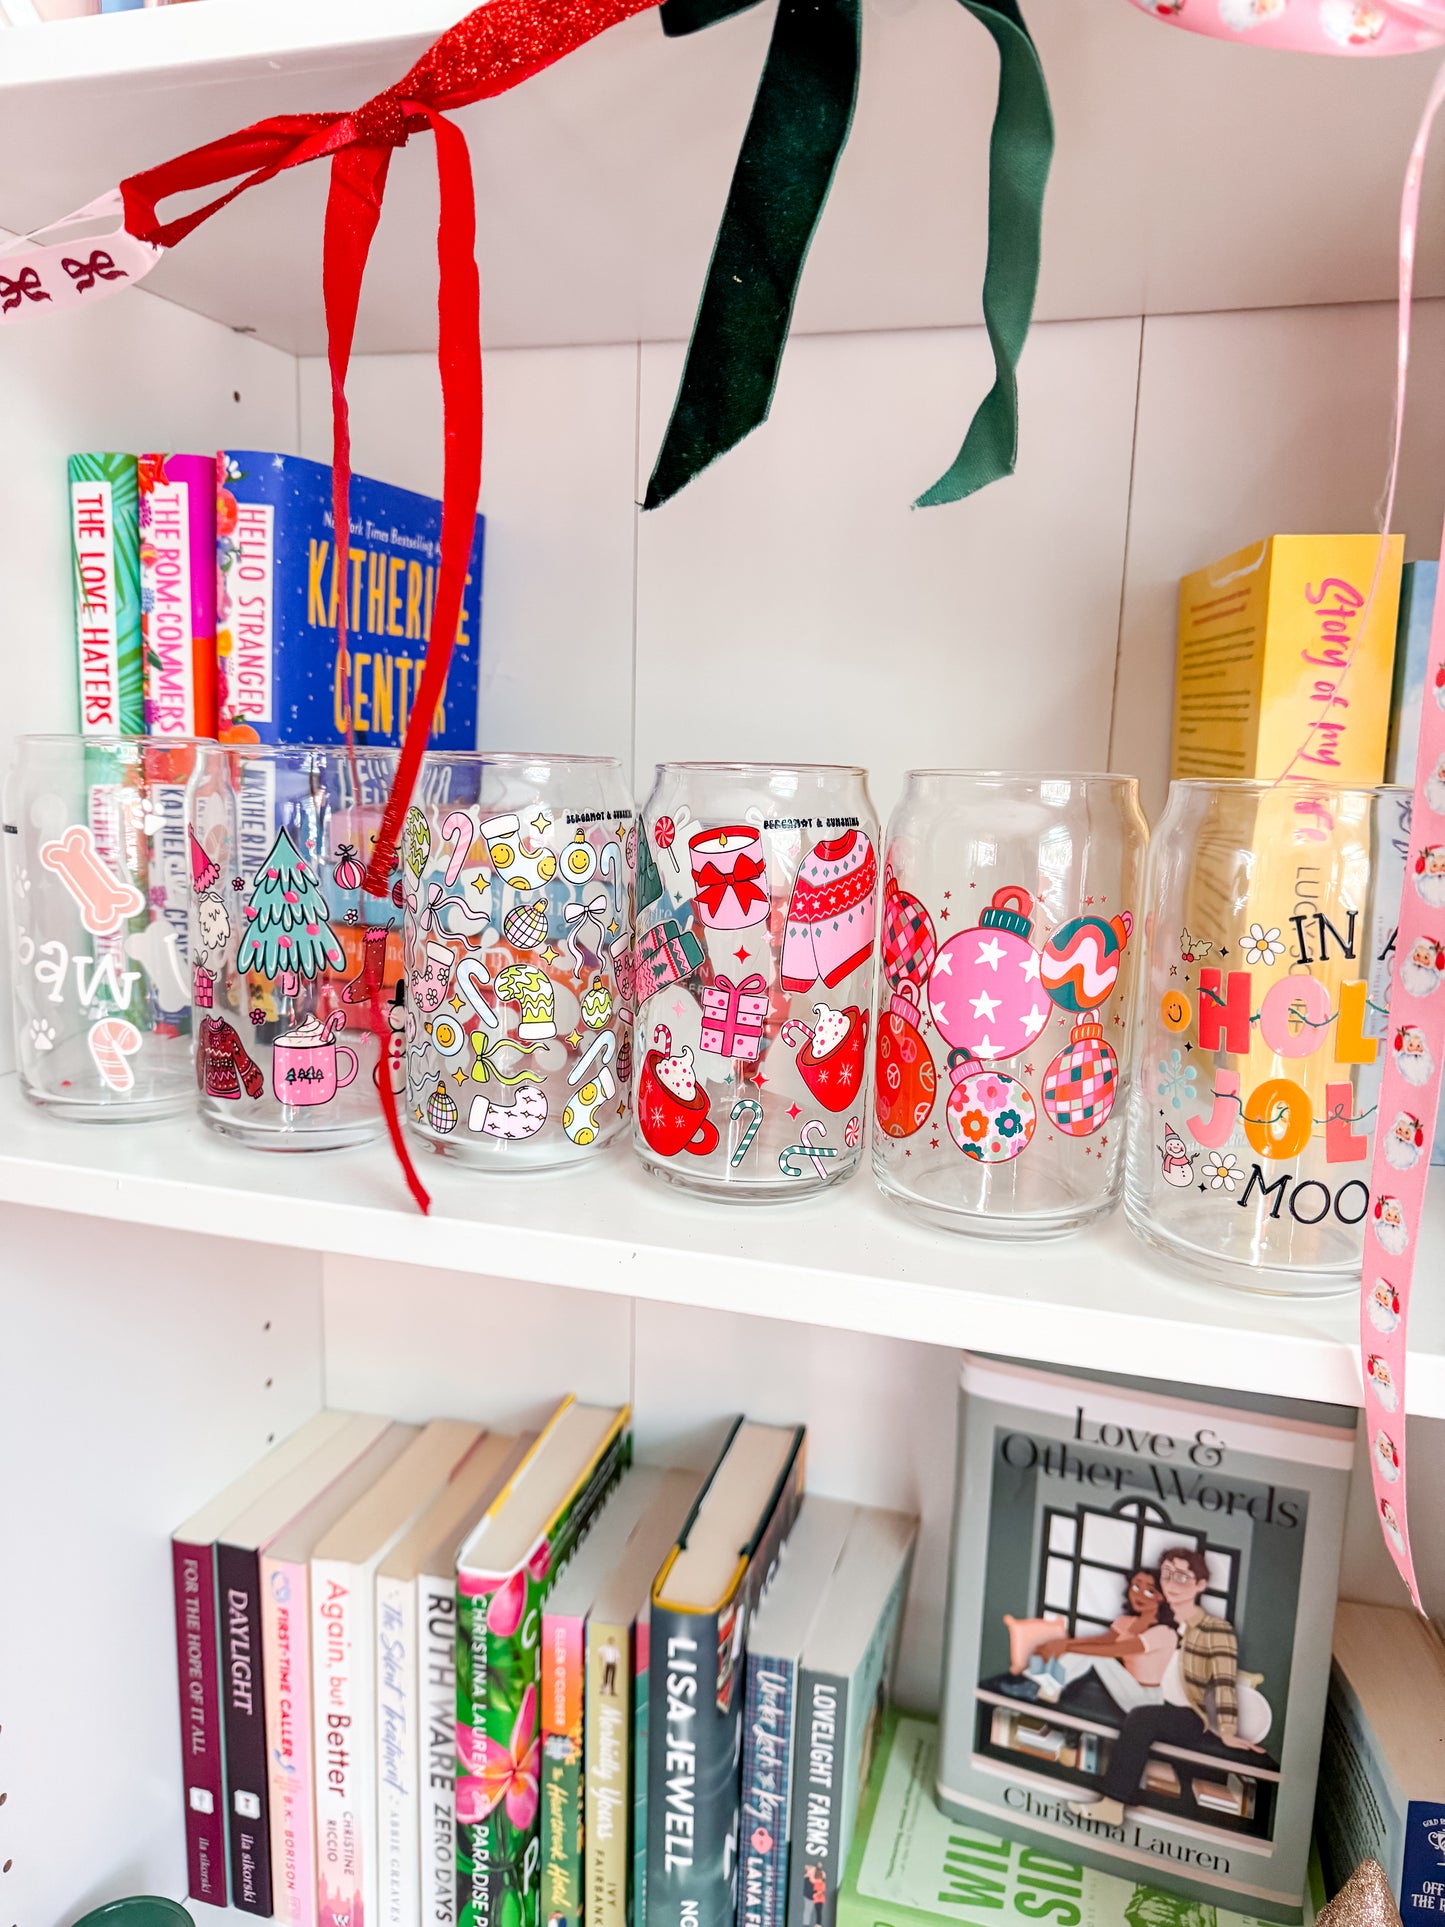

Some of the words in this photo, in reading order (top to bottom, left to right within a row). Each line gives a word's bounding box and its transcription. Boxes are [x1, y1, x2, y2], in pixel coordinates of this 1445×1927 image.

[77, 493, 105, 540] THE
[153, 494, 180, 540] THE
[237, 507, 267, 583] HELLO
[366, 520, 389, 543] Times
[390, 527, 433, 559] Bestselling
[79, 550, 108, 617] LOVE
[155, 548, 187, 734] ROM-COMMERS
[1301, 577, 1364, 668] Story
[82, 624, 113, 726] HATERS
[238, 596, 269, 719] STRANGER
[1310, 681, 1349, 709] of
[1300, 722, 1346, 767] my
[816, 818, 823, 828] &
[1289, 909, 1359, 965] IN
[1197, 967, 1379, 1065] HOL
[1186, 1068, 1369, 1164] JOL
[1237, 1163, 1370, 1225] MOO
[1074, 1406, 1176, 1459] Love
[1188, 1428, 1227, 1467] &
[1001, 1431, 1134, 1493] Other
[1148, 1462, 1300, 1530] Words
[183, 1558, 201, 1594] FOR
[185, 1595, 200, 1633] THE
[318, 1580, 353, 1669] Again,
[380, 1602, 405, 1632] The
[428, 1593, 455, 1688] RUTH
[187, 1634, 202, 1680] HOPE
[228, 1588, 254, 1715] DAYLIGHT
[276, 1607, 292, 1692] FIRST-TIME
[380, 1633, 407, 1697] Silent
[471, 1594, 488, 1697] CHRISTINA
[188, 1681, 204, 1704] OF
[329, 1676, 346, 1707] but
[665, 1637, 699, 1722] LISA
[755, 1669, 788, 1727] Under
[190, 1704, 205, 1725] IT
[191, 1725, 206, 1756] ALL
[280, 1698, 294, 1758] CALLER
[430, 1698, 455, 1792] WARE
[471, 1702, 489, 1777] LAUREN
[592, 1704, 624, 1780] Morbidly
[808, 1683, 838, 1789] LOVELIGHT
[327, 1713, 352, 1798] Better
[546, 1783, 569, 1861] Heartbreak
[590, 1786, 624, 1840] Yours
[664, 1732, 697, 1874] JEWELL
[744, 1788, 786, 1823] Key
[804, 1791, 832, 1858] FARMS
[1002, 1785, 1126, 1845] Christina
[1132, 1826, 1232, 1875] Lauren
[240, 1833, 254, 1850] ila
[284, 1830, 297, 1891] BORISON
[327, 1819, 338, 1862] RICCIO
[342, 1810, 355, 1876] CHRISTINE
[434, 1804, 452, 1865] ZERO
[241, 1852, 257, 1904] sikorski
[434, 1868, 453, 1922] DAYS
[471, 1824, 490, 1909] PARADISE
[546, 1862, 572, 1908] Hotel
[593, 1849, 606, 1926] FAIRBANK
[607, 1882, 617, 1908] IVY
[745, 1856, 763, 1907] LANA
[937, 1835, 1012, 1910] WIL
[1013, 1846, 1087, 1927] SID
[1411, 1894, 1436, 1910] THE
